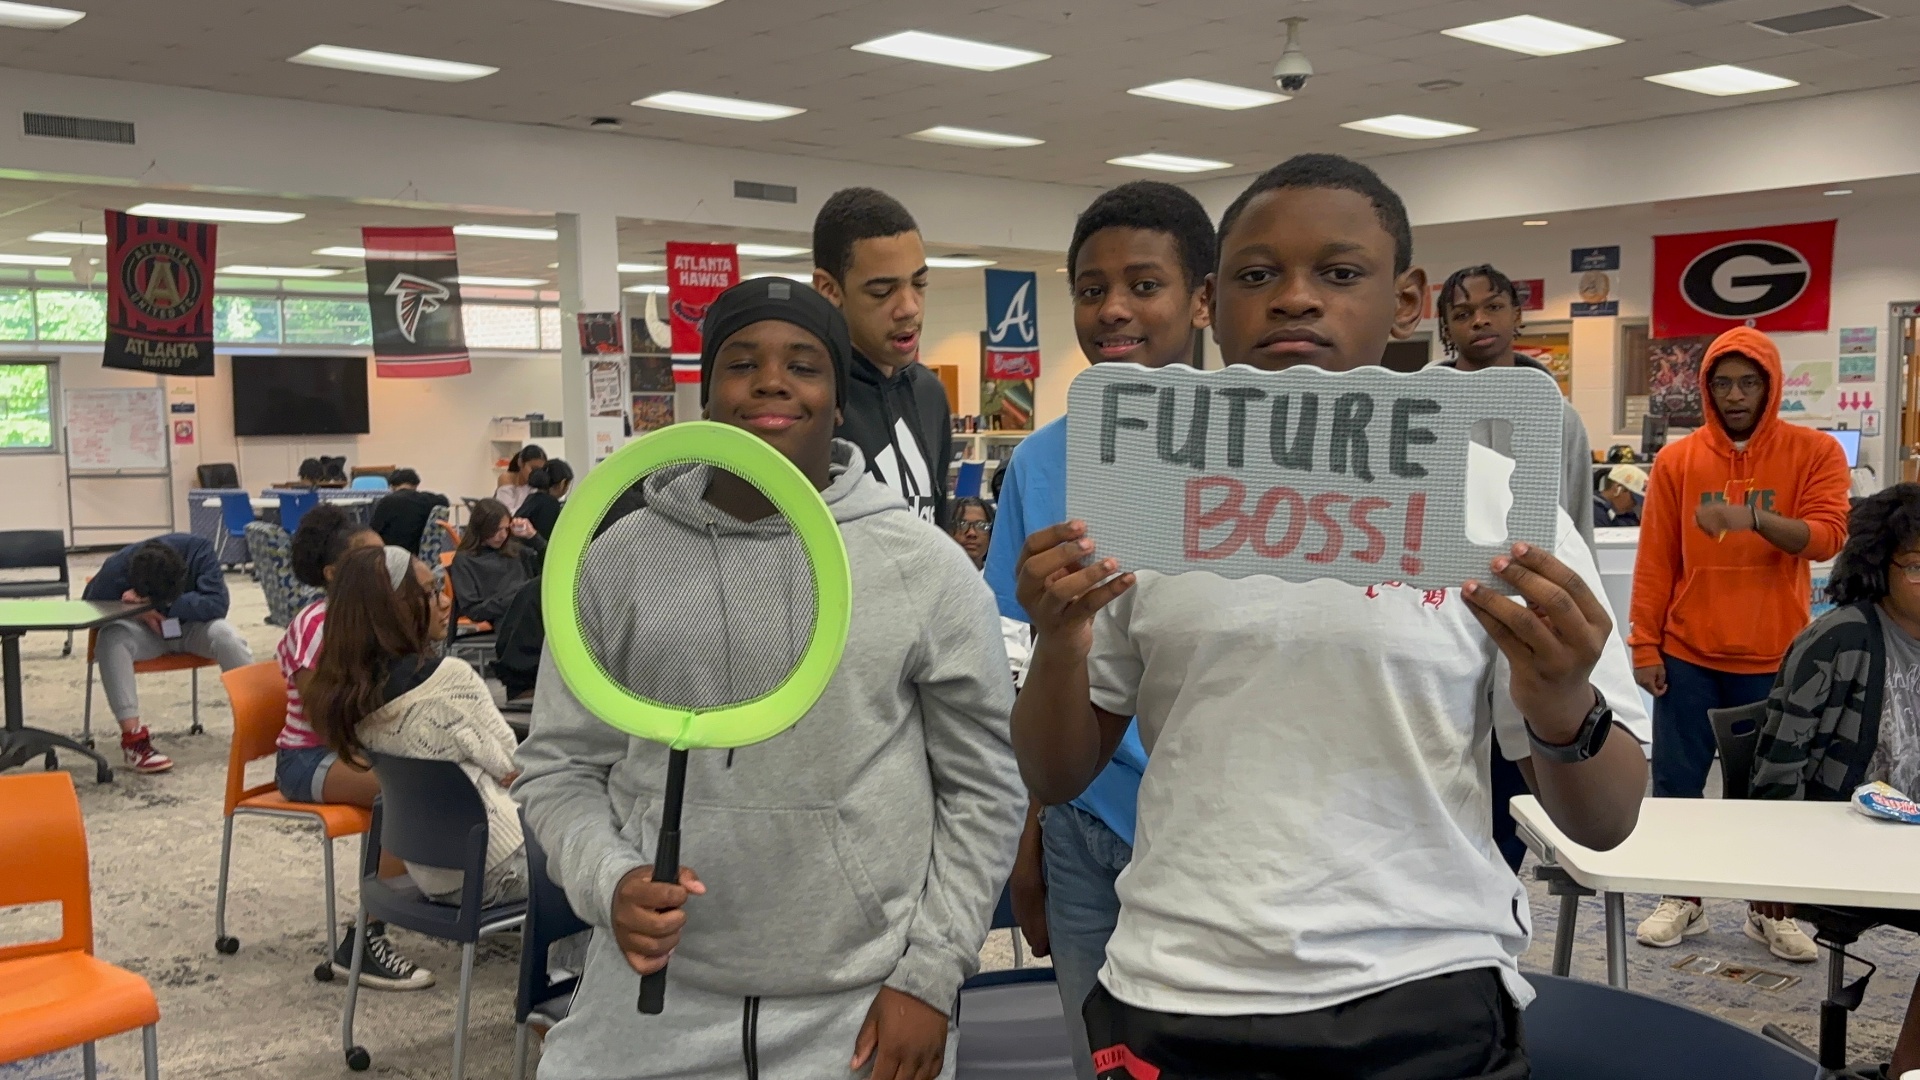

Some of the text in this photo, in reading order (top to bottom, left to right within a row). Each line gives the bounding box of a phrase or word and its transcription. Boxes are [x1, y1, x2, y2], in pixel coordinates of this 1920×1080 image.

[134, 243, 191, 266] ATLANTA
[674, 255, 732, 272] ATLANTA
[143, 261, 180, 306] A
[680, 271, 728, 288] HAWKS
[1680, 240, 1811, 319] G
[989, 279, 1034, 343] A
[124, 337, 199, 359] ATLANTA
[141, 356, 183, 368] UNITED
[1100, 382, 1442, 484] FUTURE
[1183, 474, 1427, 577] BOSS!
